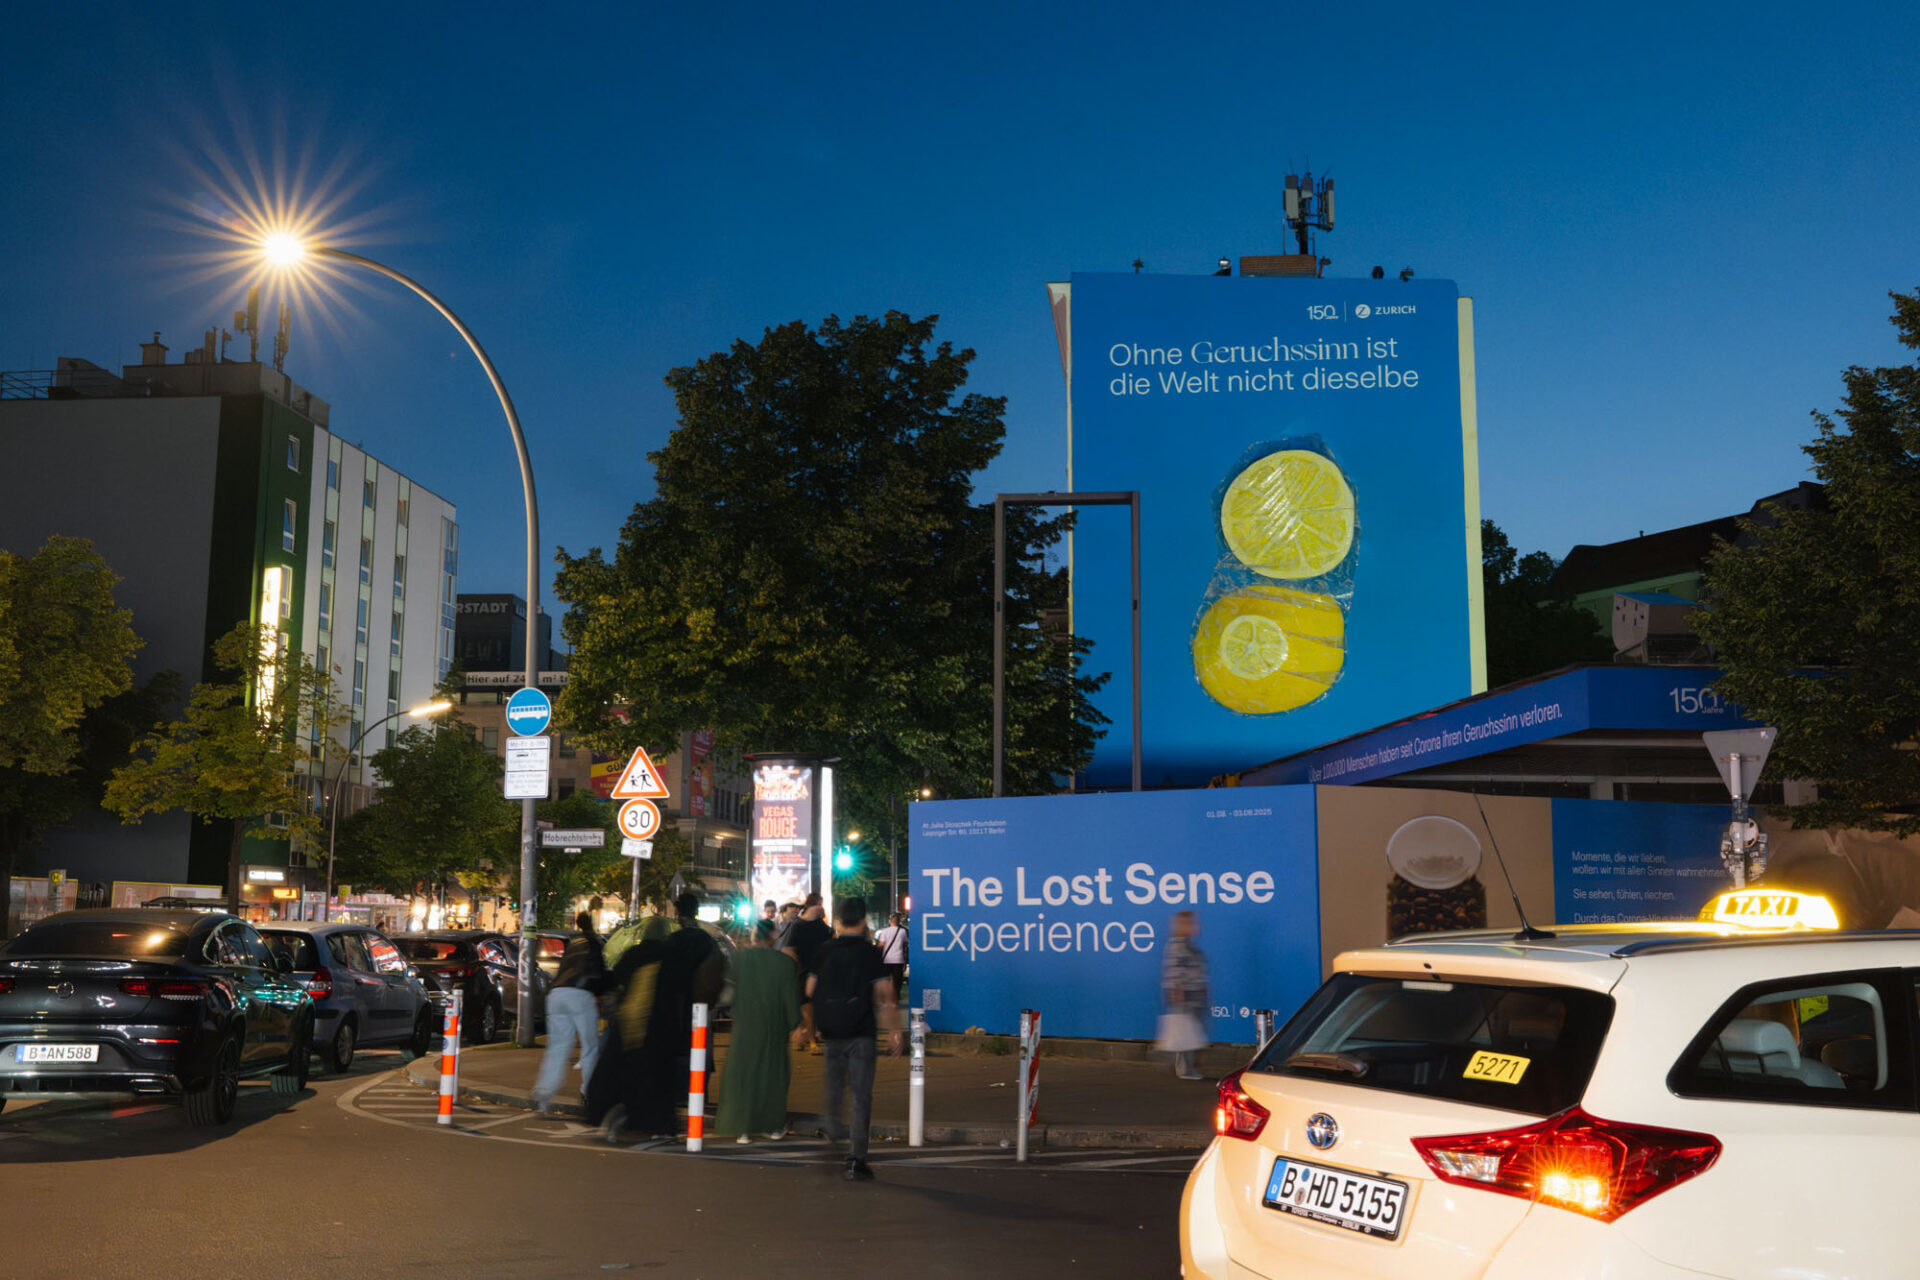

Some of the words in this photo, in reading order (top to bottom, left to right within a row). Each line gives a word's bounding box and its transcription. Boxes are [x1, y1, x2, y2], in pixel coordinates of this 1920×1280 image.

[1375, 305, 1416, 315] ZURICH
[1109, 343, 1183, 366] Ohne
[1190, 337, 1359, 364] Geruchssinn
[1366, 337, 1398, 358] ist
[1109, 372, 1150, 396] die
[1158, 370, 1220, 394] Welt
[1228, 368, 1294, 392] nicht
[1302, 364, 1419, 390] dieselbe
[467, 674, 488, 683] Hier
[493, 674, 510, 683] auf
[1346, 754, 1379, 773] Menschen
[1378, 747, 1400, 766] haben
[1400, 741, 1413, 759] seit
[1414, 736, 1441, 755] Corona
[1442, 729, 1463, 748] ihren
[1463, 715, 1518, 743] Geruchssinn
[1519, 703, 1563, 728] verloren.
[628, 810, 650, 828] 30
[762, 806, 794, 817] VEGAS
[759, 817, 798, 838] ROUGE
[1571, 851, 1613, 864] Momente,
[1614, 852, 1626, 862] die
[1628, 853, 1639, 862] wir
[1641, 852, 1667, 864] lieben,
[1572, 865, 1599, 875] wollen
[1601, 865, 1612, 875] wir
[1613, 866, 1626, 875] mit
[1627, 865, 1645, 875] allen
[1647, 866, 1675, 876] Sinnen
[921, 867, 1003, 907] The
[1016, 866, 1113, 906] Lost
[1124, 862, 1275, 905] Sense
[1572, 888, 1587, 899] Sie
[1588, 889, 1615, 900] sehen,
[1616, 889, 1643, 900] fühlen,
[1735, 897, 1791, 915] TAXI
[1574, 913, 1599, 924] Durch
[1602, 913, 1616, 923] das
[921, 913, 1155, 962] Experience
[29, 1047, 38, 1059] B
[47, 1047, 65, 1059] AN
[67, 1047, 92, 1059] 588
[1473, 1056, 1520, 1079] 5271
[1280, 1168, 1297, 1198] B
[1306, 1173, 1338, 1209] HD
[1339, 1180, 1400, 1224] 5155
